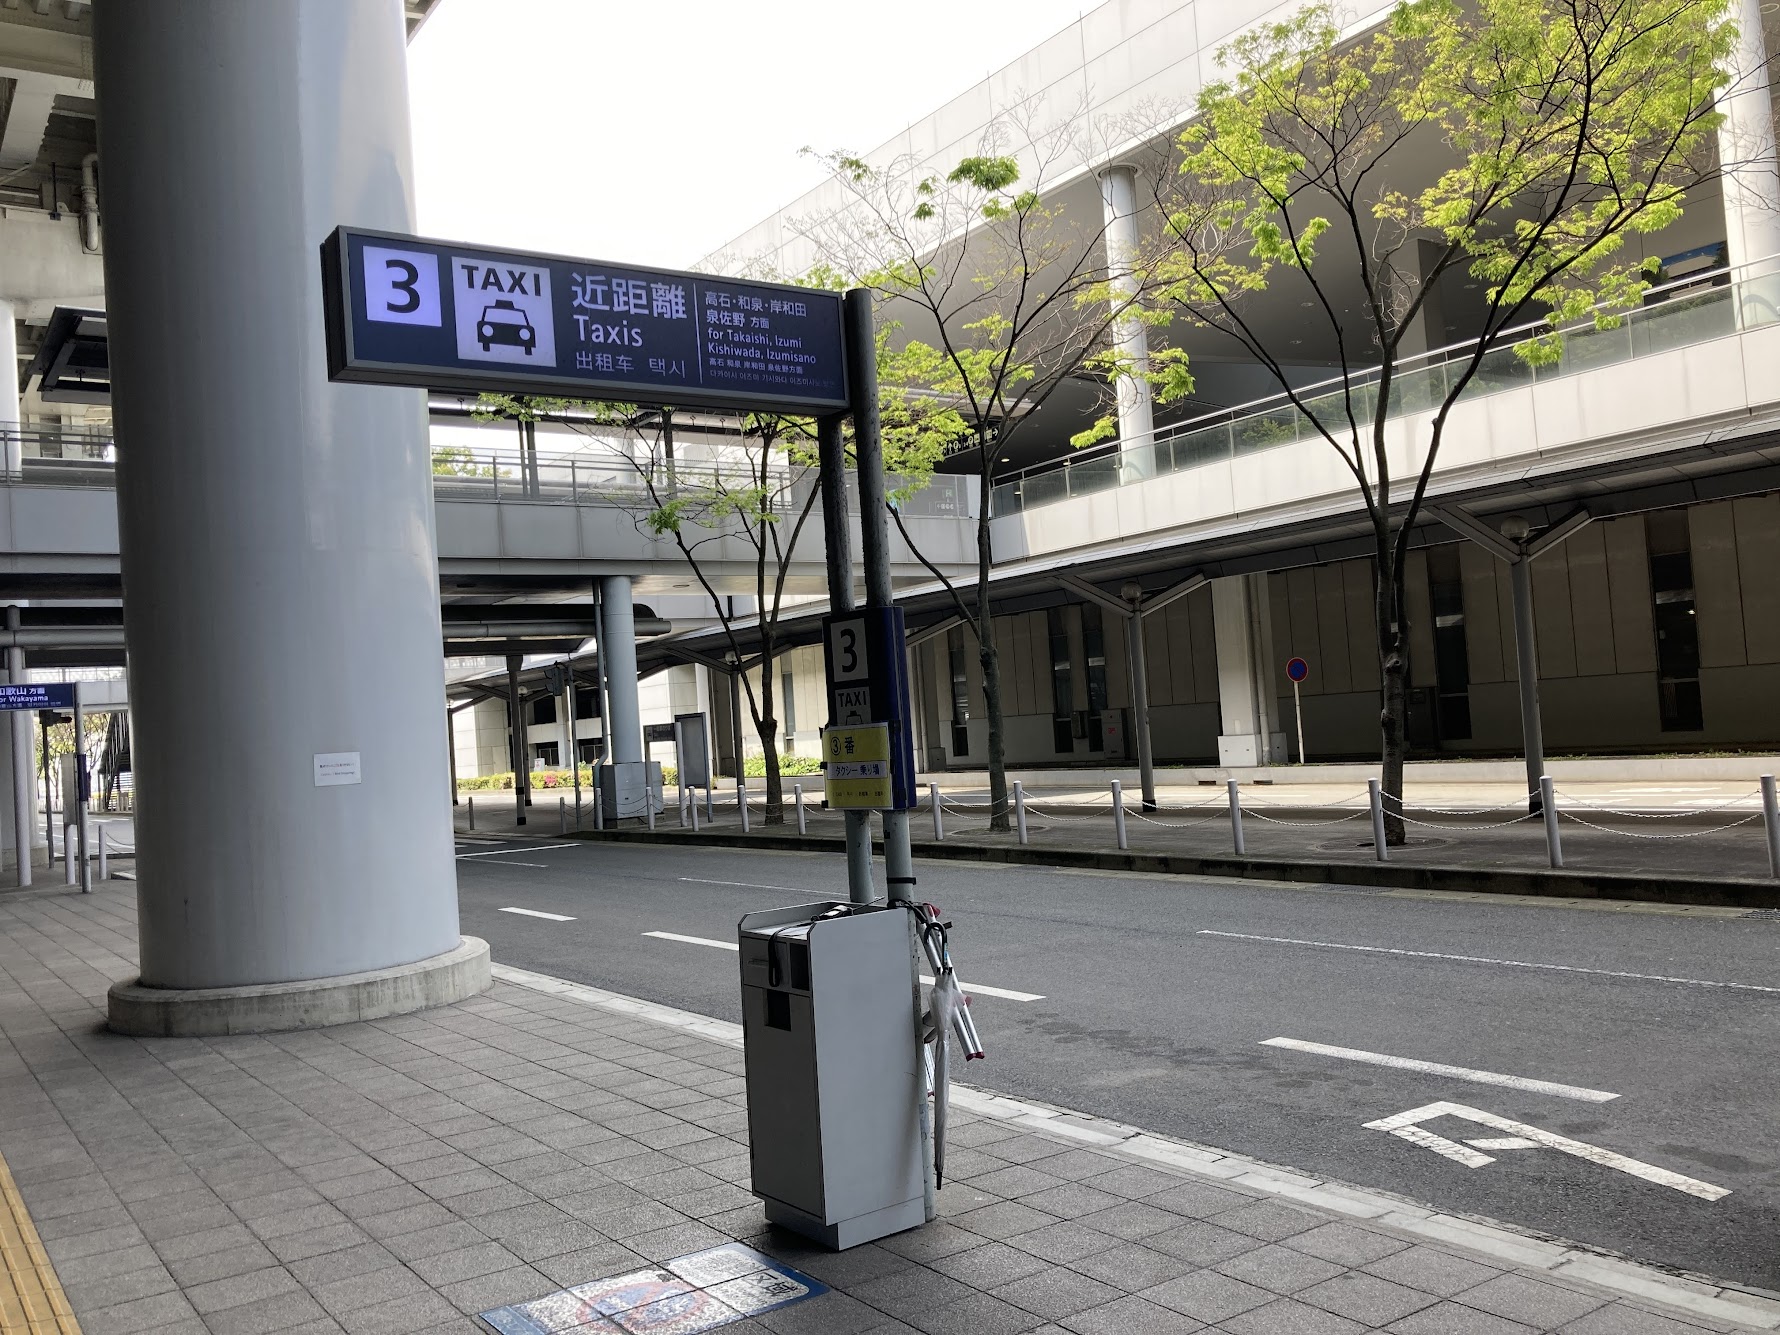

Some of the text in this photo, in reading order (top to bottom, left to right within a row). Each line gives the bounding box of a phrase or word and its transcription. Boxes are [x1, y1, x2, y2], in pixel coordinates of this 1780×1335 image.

[385, 260, 421, 313] 3
[461, 264, 541, 297] TAXI
[571, 272, 687, 319] 近距離
[573, 315, 643, 347] Taxis
[706, 310, 769, 329] 泉佐野 方面
[708, 328, 802, 348] for Takaishi, Izumi
[708, 342, 816, 363] Kishiwada, Izumisano
[576, 351, 686, 378] 出租车 택시
[840, 629, 858, 673] 3
[838, 690, 867, 708] TAXI
